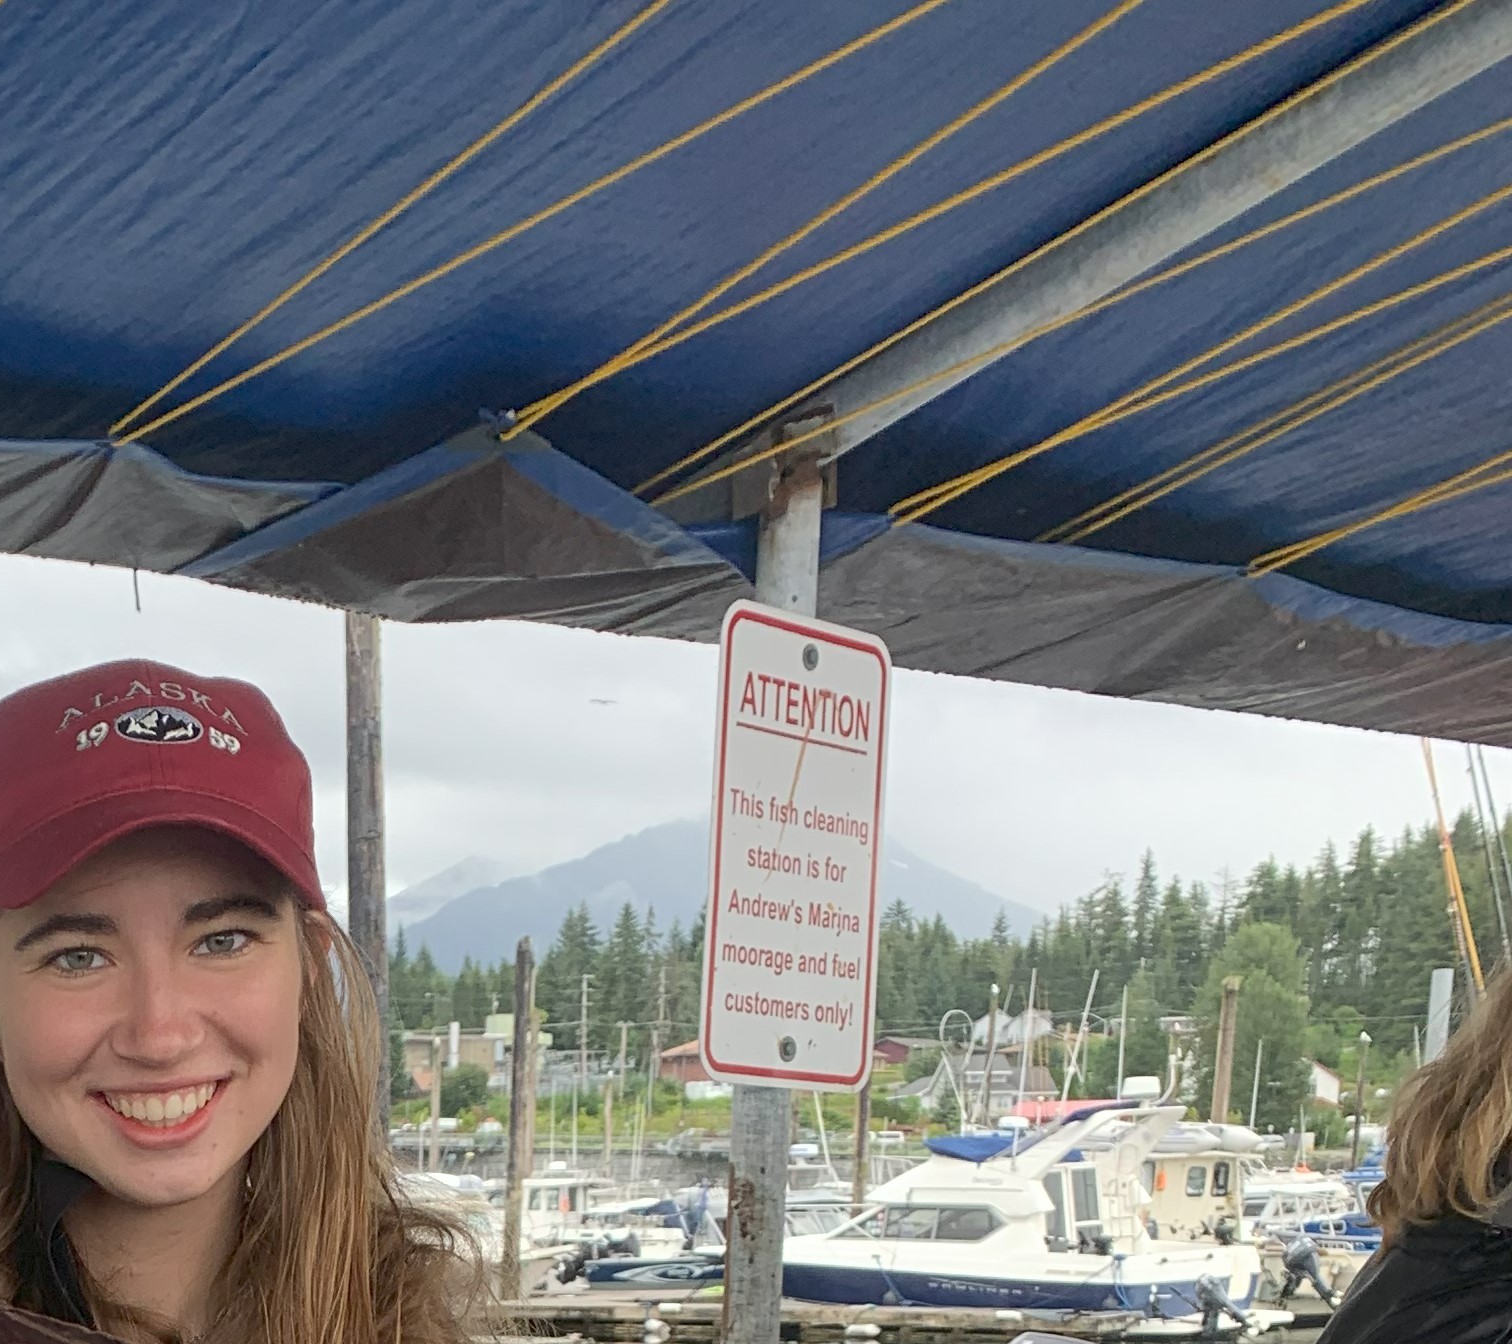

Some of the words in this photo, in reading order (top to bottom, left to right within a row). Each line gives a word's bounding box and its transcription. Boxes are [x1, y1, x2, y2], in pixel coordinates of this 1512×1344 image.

[55, 680, 248, 736] ALASKA
[740, 671, 870, 741] ATTENTION
[76, 721, 110, 751] 19
[209, 726, 241, 755] 59
[730, 788, 764, 819] This
[770, 796, 798, 826] fish
[803, 805, 868, 846] cleaning
[747, 845, 802, 875] station
[806, 853, 820, 879] is
[825, 856, 847, 883] for
[727, 888, 803, 925] Andrew's
[808, 902, 860, 934] Marina
[722, 942, 793, 976] moorage
[798, 951, 827, 976] and
[831, 953, 861, 981] fuel
[724, 991, 810, 1022] customers
[814, 1000, 854, 1032] only!
